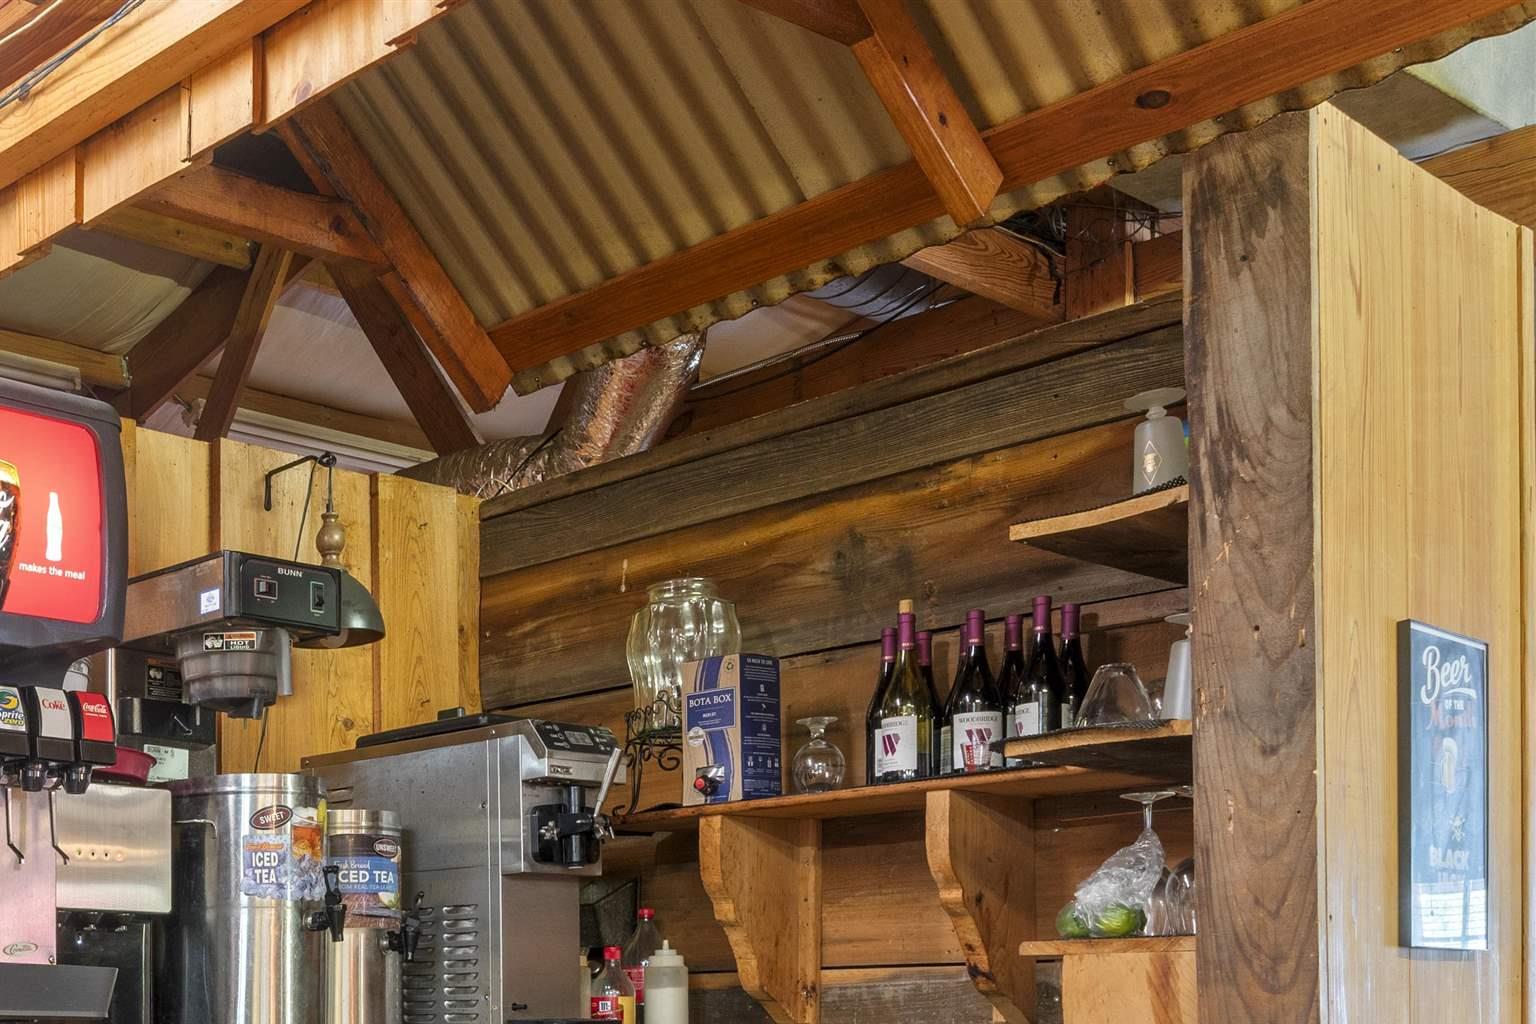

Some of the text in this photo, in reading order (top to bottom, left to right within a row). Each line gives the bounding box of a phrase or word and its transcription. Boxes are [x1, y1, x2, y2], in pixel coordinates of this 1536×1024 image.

[19, 563, 85, 580] makes the meal
[277, 567, 303, 577] BUNN
[1421, 646, 1473, 704] Beer
[42, 698, 65, 711] Coke
[689, 693, 733, 708] BOTA BOX
[260, 811, 285, 825] SWEET
[252, 852, 279, 867] ICED
[254, 869, 277, 884] TEA
[338, 870, 395, 883] CED TEA
